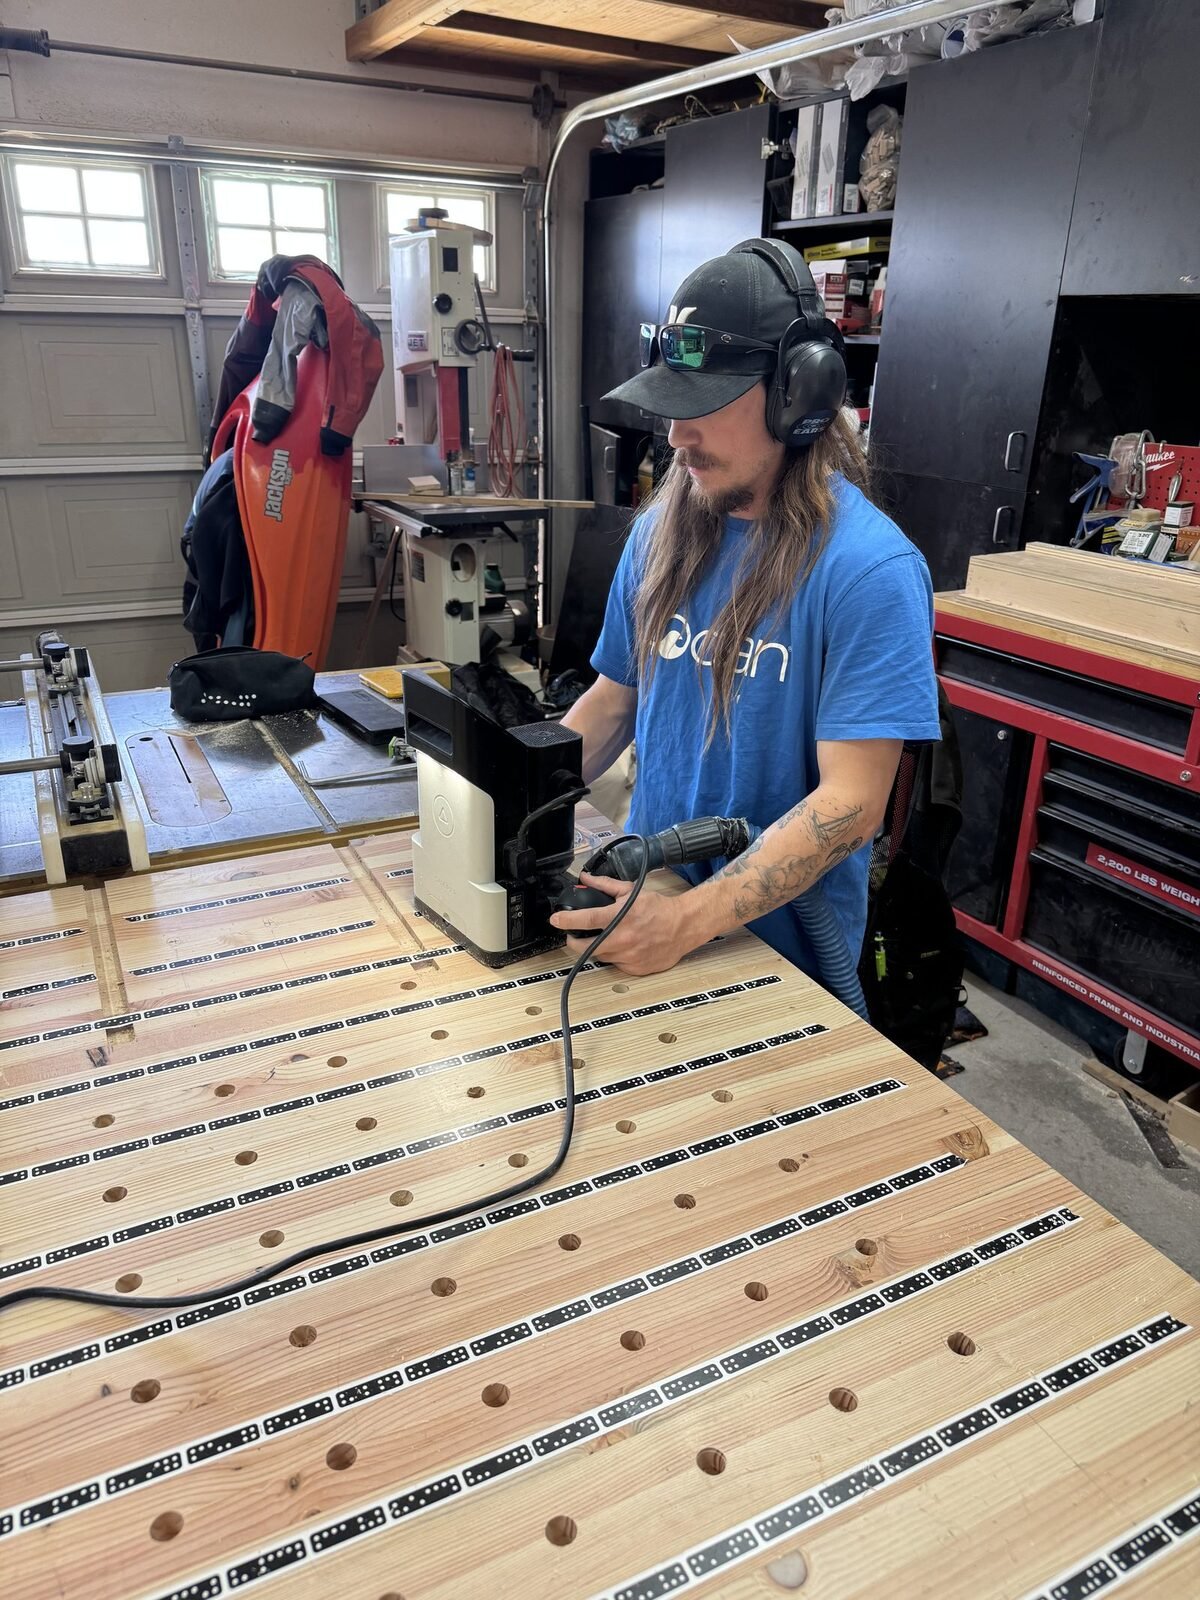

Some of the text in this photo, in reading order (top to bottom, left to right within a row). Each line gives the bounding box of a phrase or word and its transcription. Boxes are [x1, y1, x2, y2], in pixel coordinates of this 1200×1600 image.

[802, 417, 830, 425] PRO
[1145, 450, 1176, 464] aukee
[1097, 854, 1132, 875] 2,200
[1134, 870, 1158, 887] LBS
[1032, 959, 1087, 995] REINFORCED
[1089, 992, 1122, 1015] FRAME
[1122, 1011, 1144, 1027] AND
